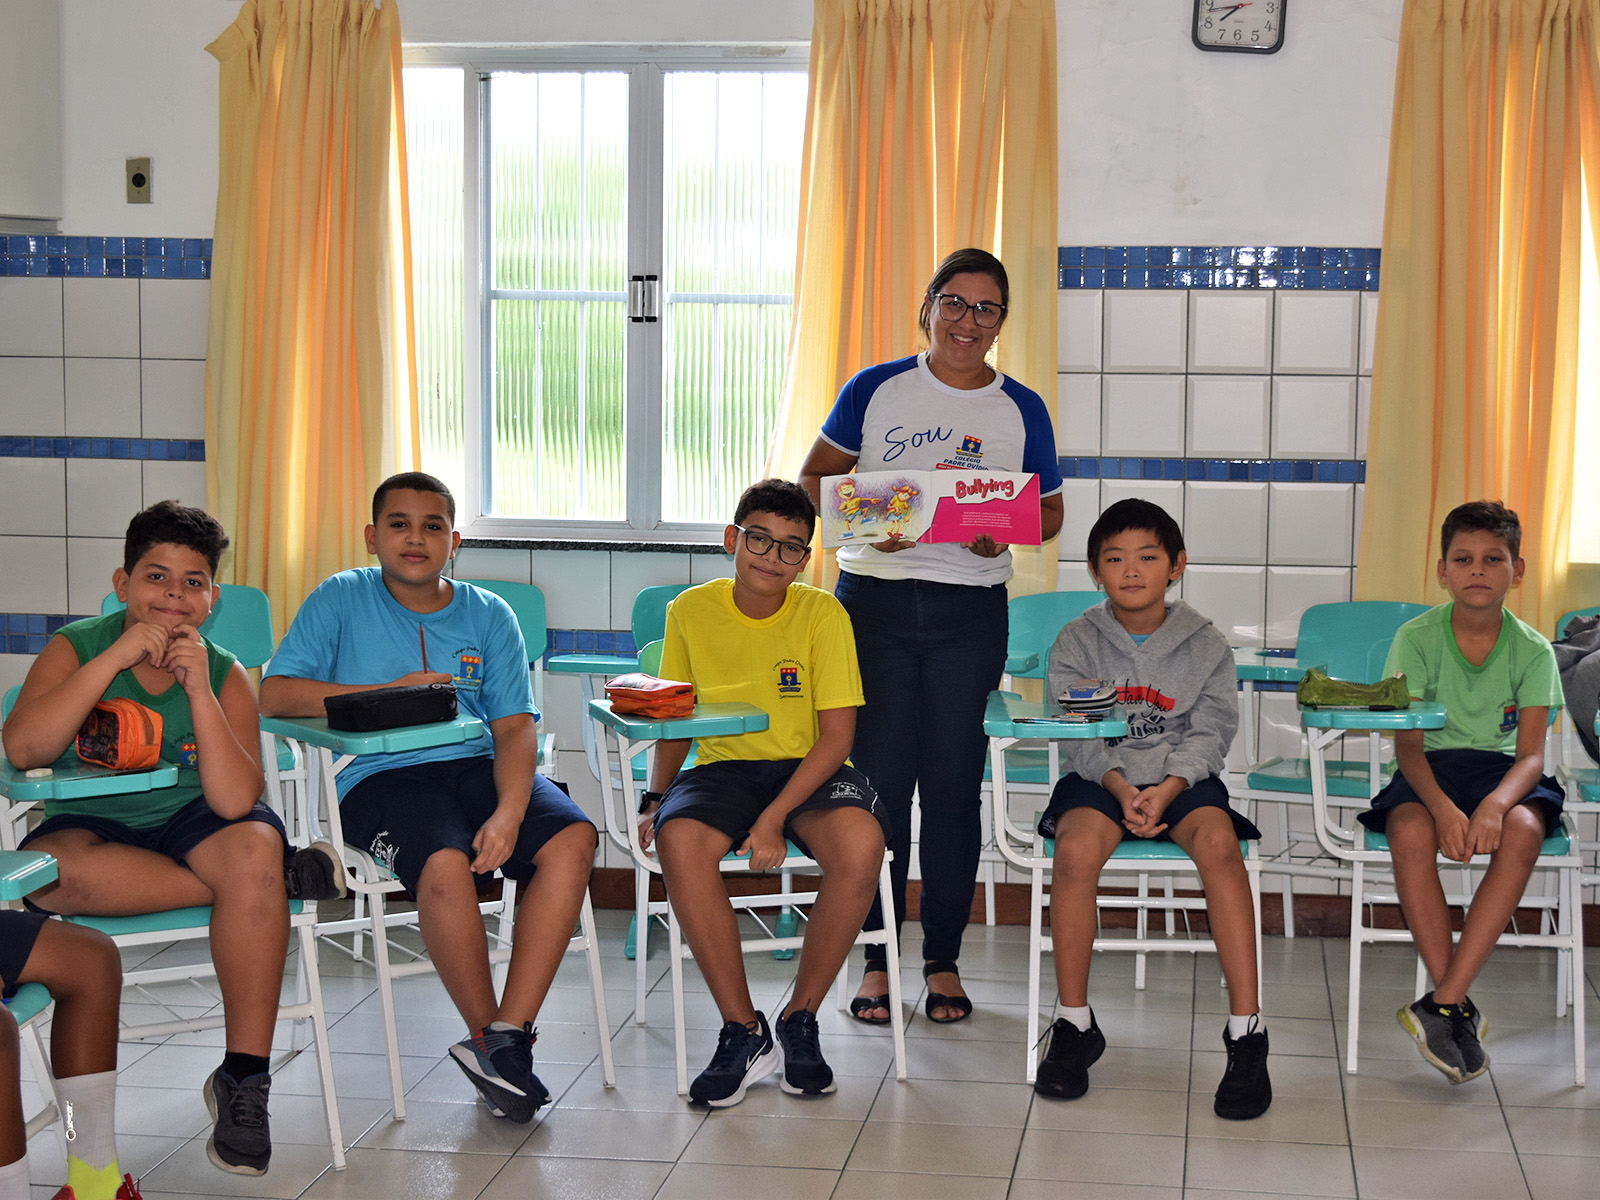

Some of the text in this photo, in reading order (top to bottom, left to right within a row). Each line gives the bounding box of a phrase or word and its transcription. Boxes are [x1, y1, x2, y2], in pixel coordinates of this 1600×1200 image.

[1266, 2, 1275, 14] 3
[1203, 17, 1213, 29] 8
[1264, 20, 1273, 32] 4
[1218, 29, 1226, 40] 7
[1233, 29, 1242, 41] 6
[1250, 30, 1260, 42] 5
[883, 426, 953, 462] Sou
[943, 458, 967, 468] PADRE
[955, 478, 1014, 499] Bullying
